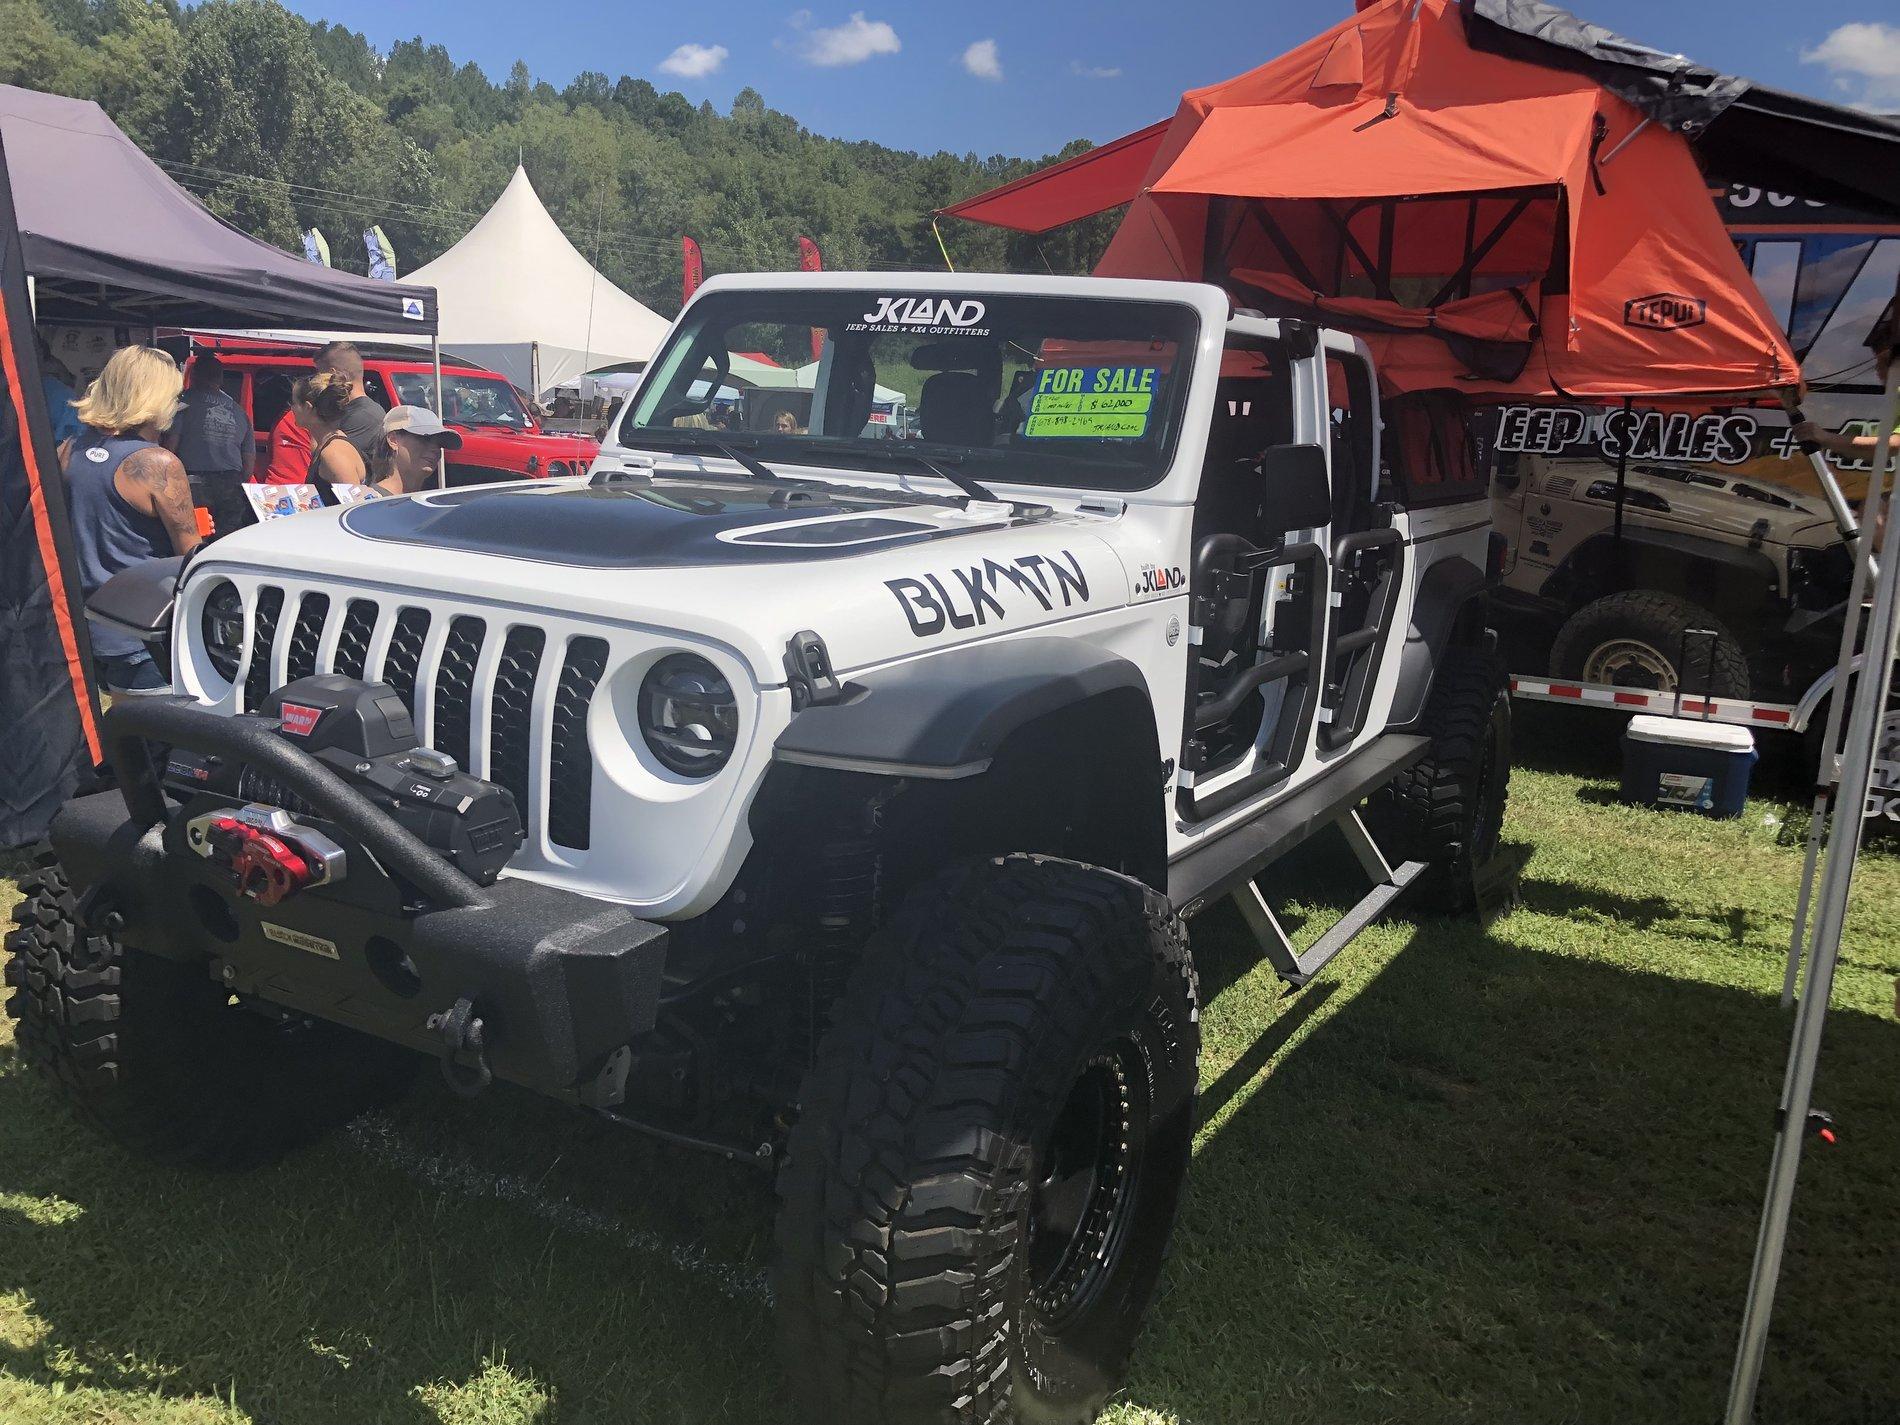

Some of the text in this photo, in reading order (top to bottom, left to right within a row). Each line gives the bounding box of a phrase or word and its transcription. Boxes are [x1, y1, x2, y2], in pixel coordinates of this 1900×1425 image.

[863, 297, 986, 327] JKLAND
[1635, 299, 1695, 325] TEPUI
[845, 323, 991, 337] JEEP SALES 4X4 OUTFITTERS
[1038, 368, 1155, 393] FOR SALE
[1602, 408, 1758, 465] SALES
[1142, 566, 1181, 593] JKLAND
